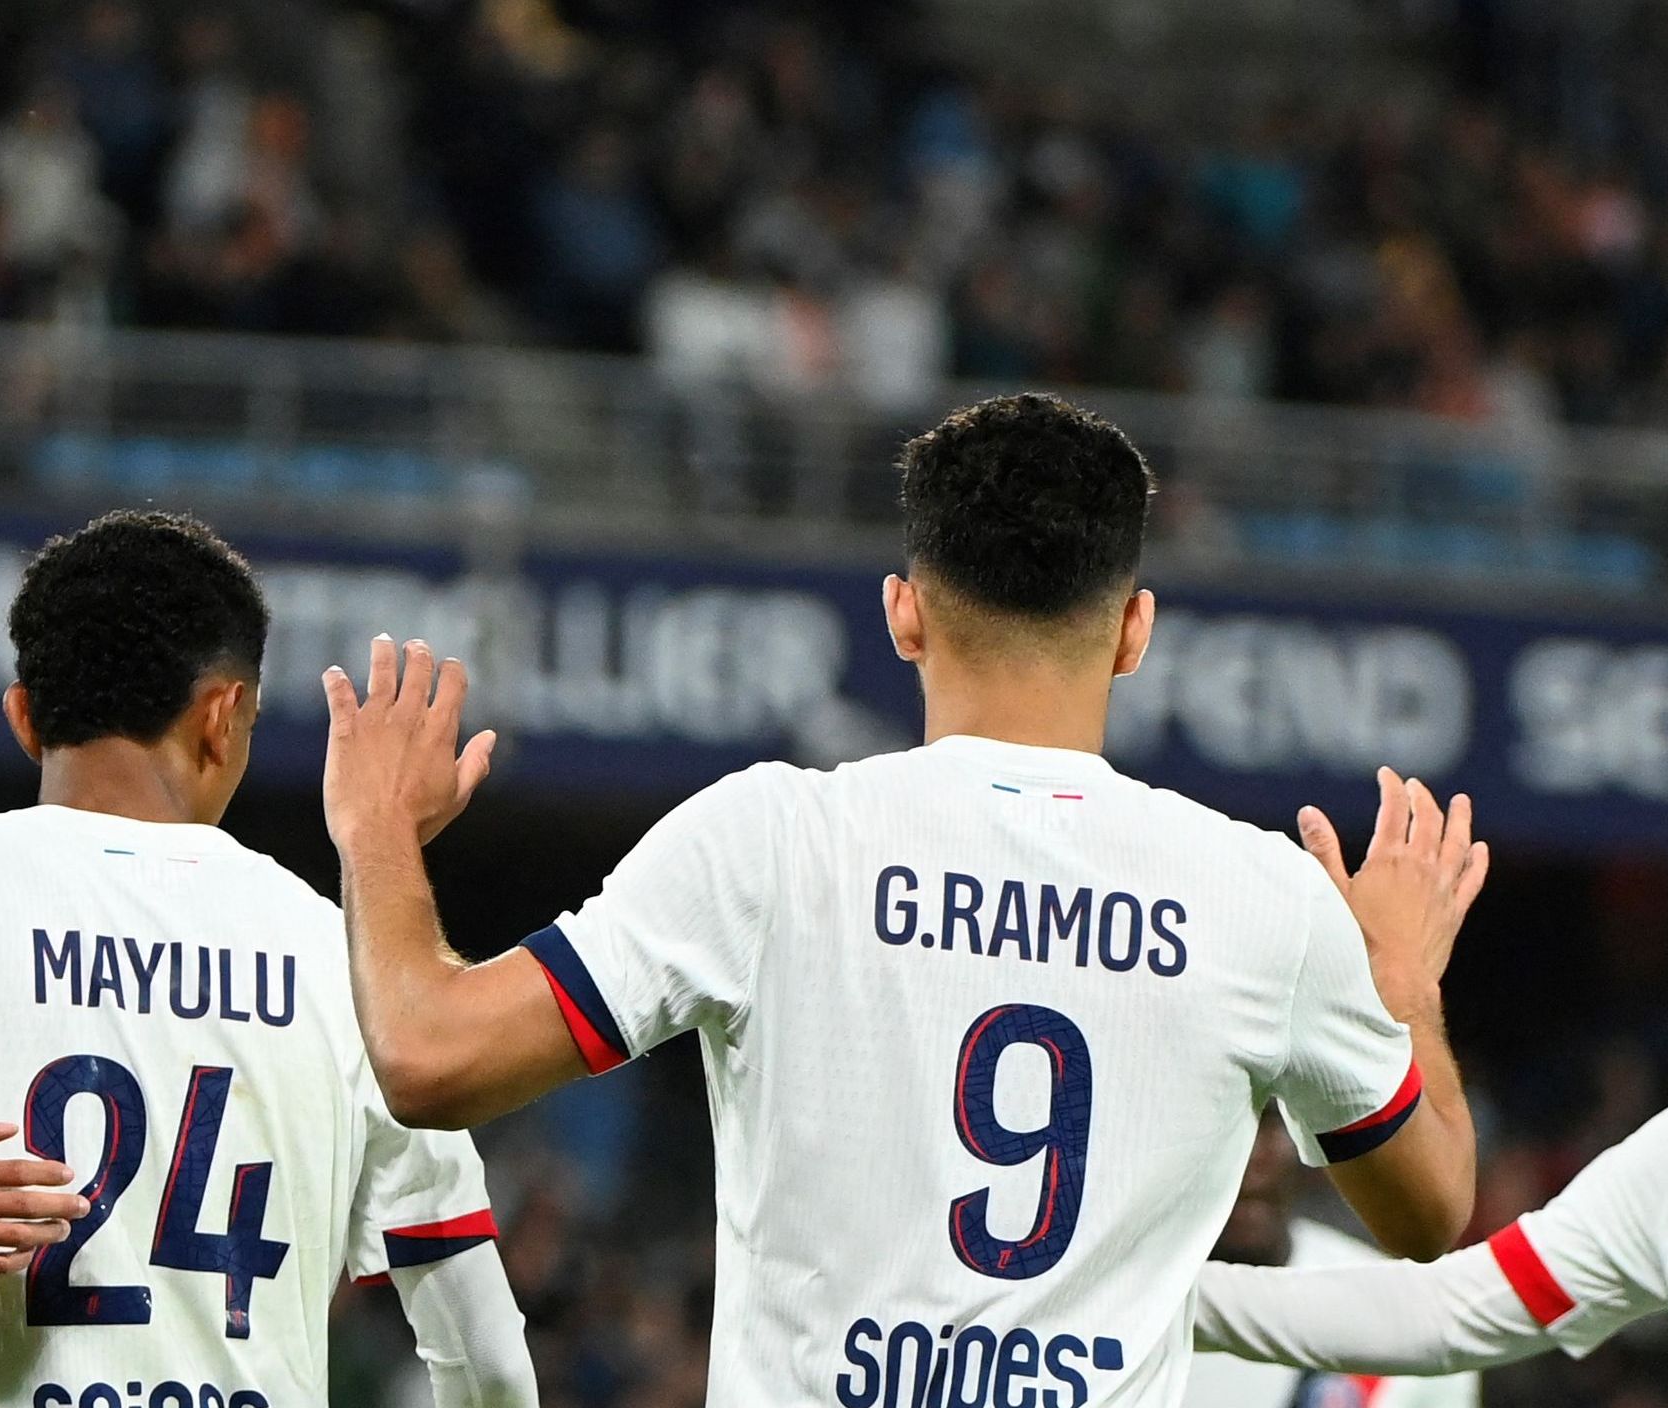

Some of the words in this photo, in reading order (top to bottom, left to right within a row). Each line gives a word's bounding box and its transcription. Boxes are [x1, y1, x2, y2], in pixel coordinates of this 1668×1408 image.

[32, 928, 295, 1028] MAYULU
[874, 865, 1188, 978] G.RAMOS
[23, 1054, 290, 1340] 24
[948, 1003, 1093, 1281] 9
